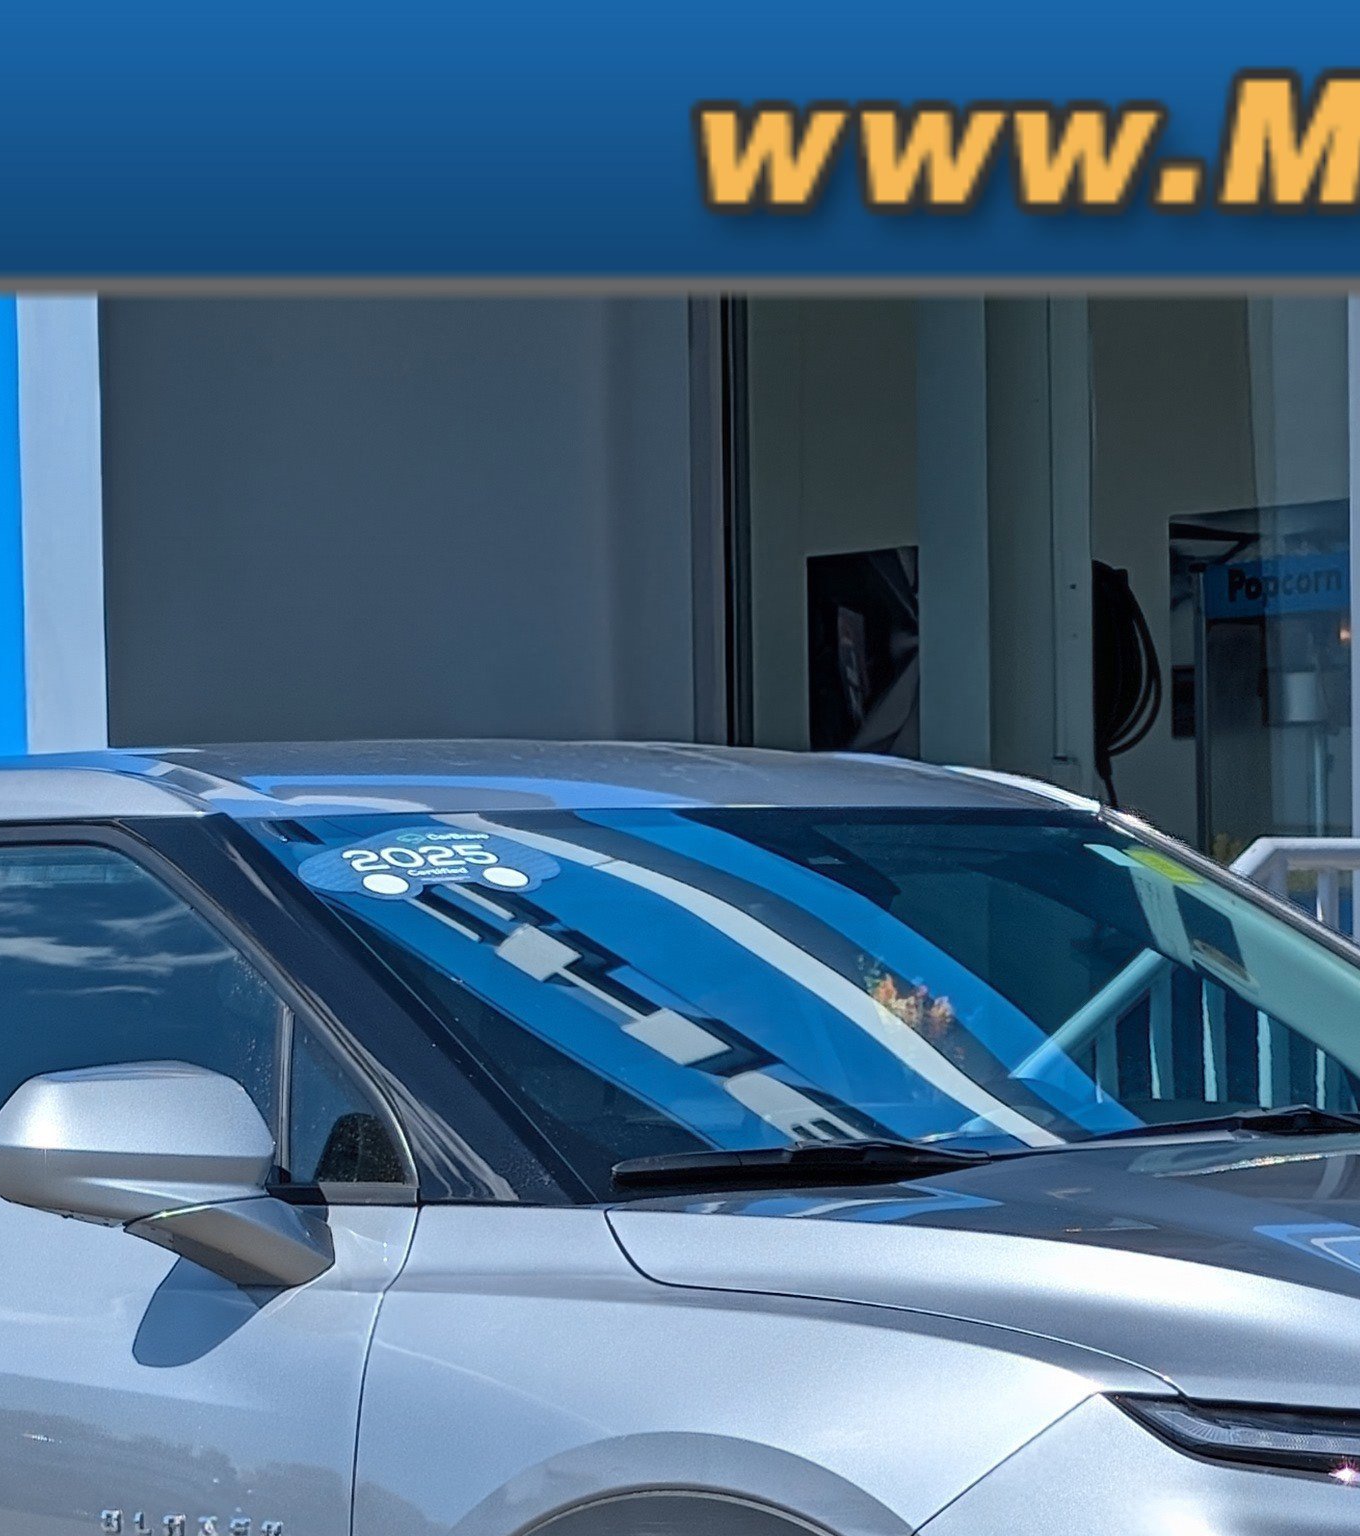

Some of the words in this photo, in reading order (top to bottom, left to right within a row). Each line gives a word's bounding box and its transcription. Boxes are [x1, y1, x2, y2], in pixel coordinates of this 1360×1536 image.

[1227, 566, 1342, 606] Popcorn
[341, 843, 500, 873] 2025
[406, 867, 469, 878] Certified
